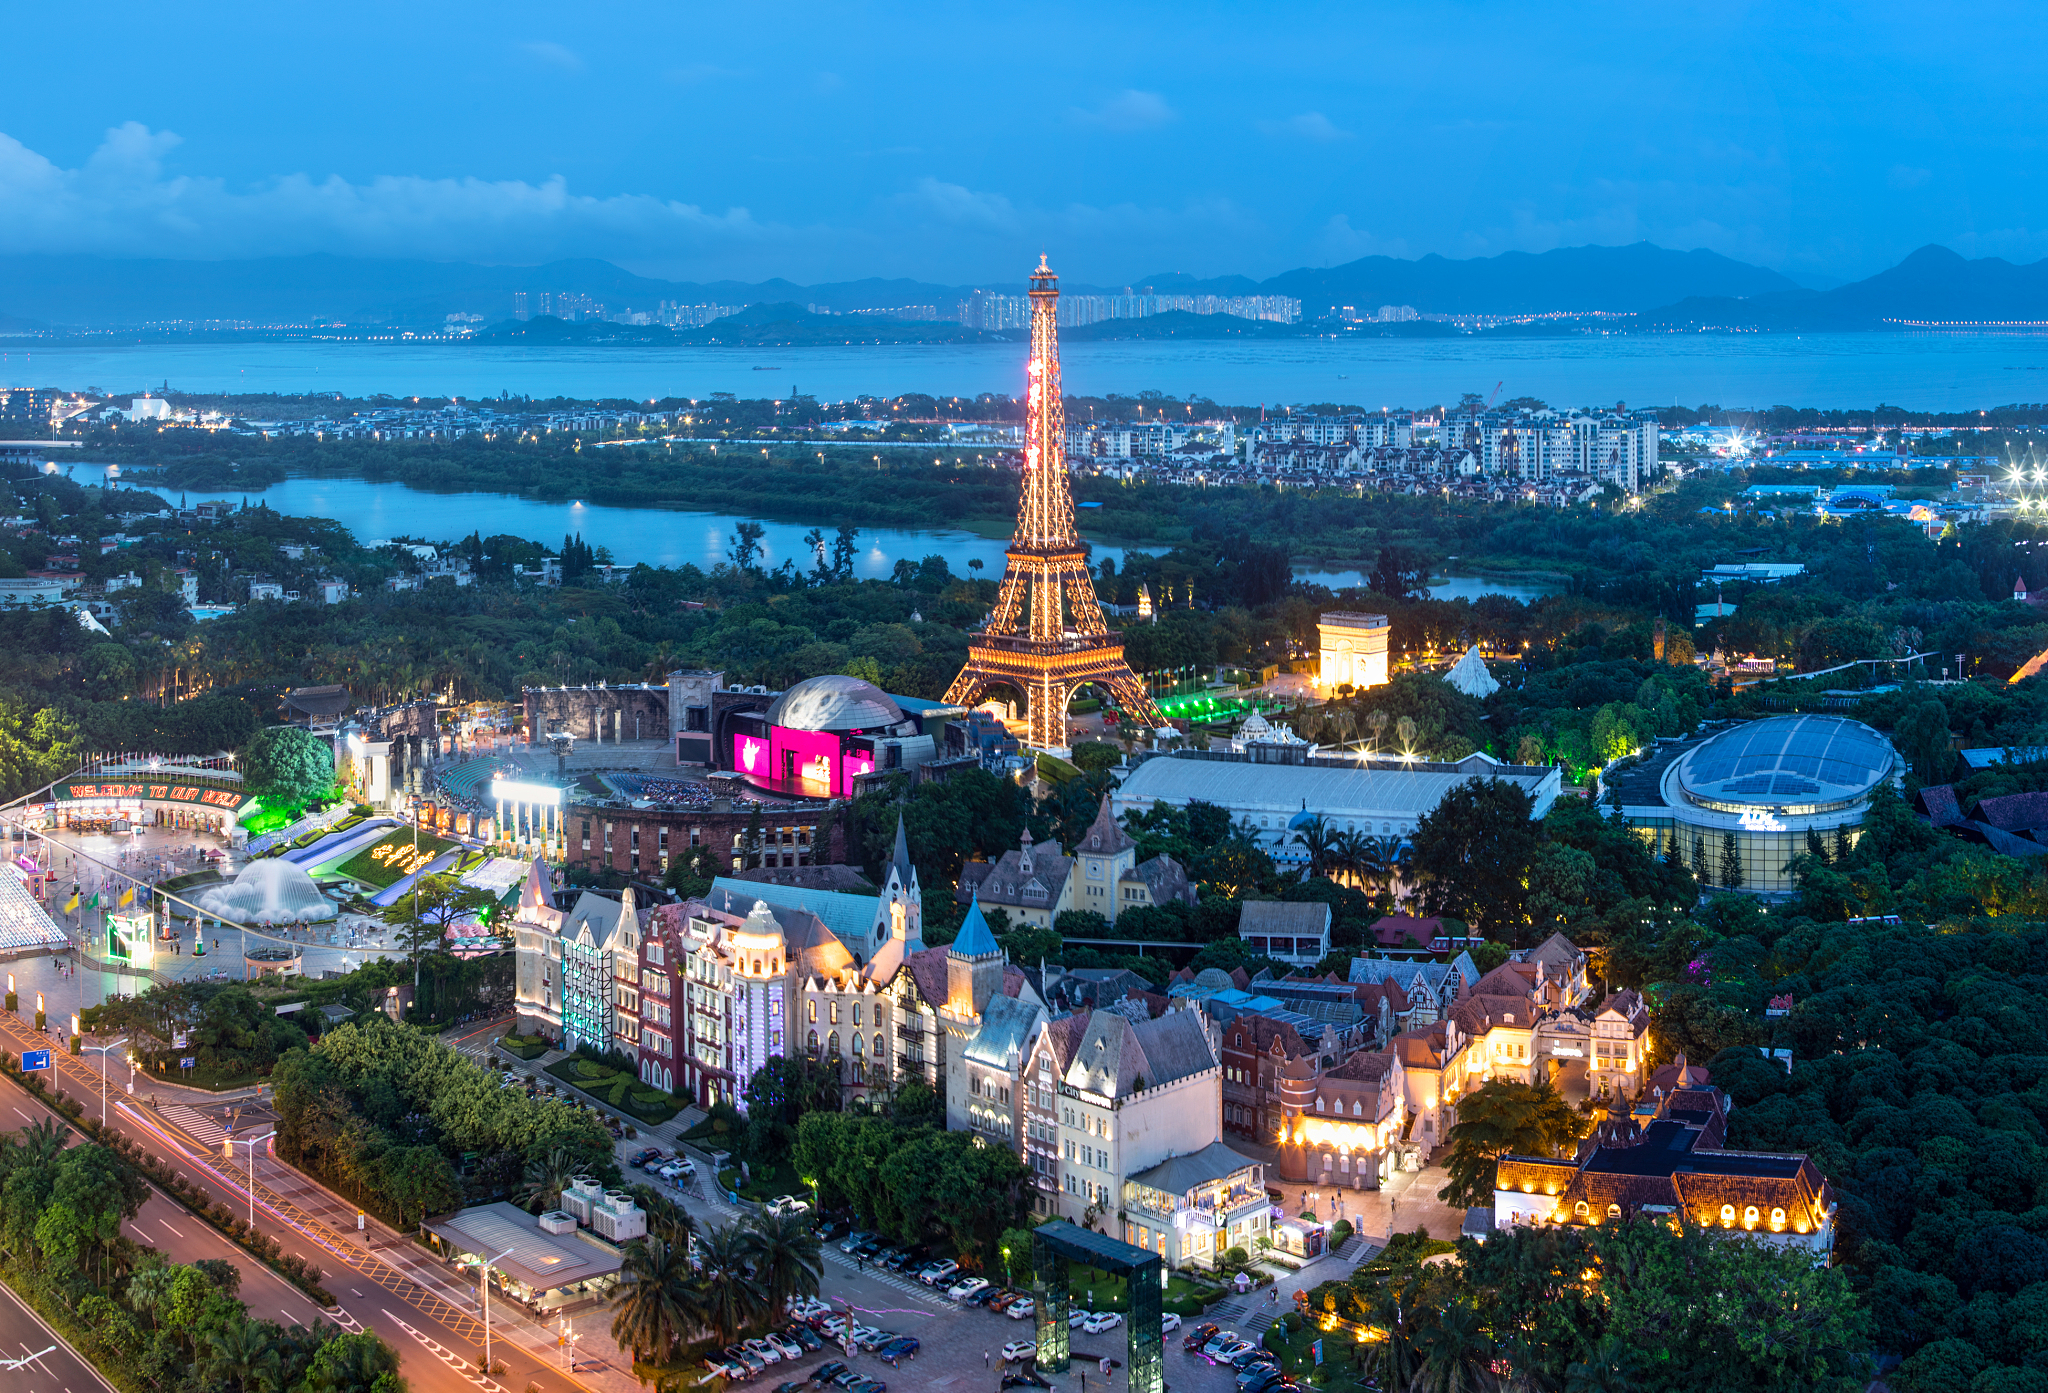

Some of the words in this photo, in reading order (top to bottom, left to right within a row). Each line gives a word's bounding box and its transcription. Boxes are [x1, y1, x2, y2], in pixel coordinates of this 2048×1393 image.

[70, 785, 143, 798] WELCOME
[149, 785, 168, 799] TO
[170, 786, 200, 801] OUR
[201, 789, 242, 808] WORLD
